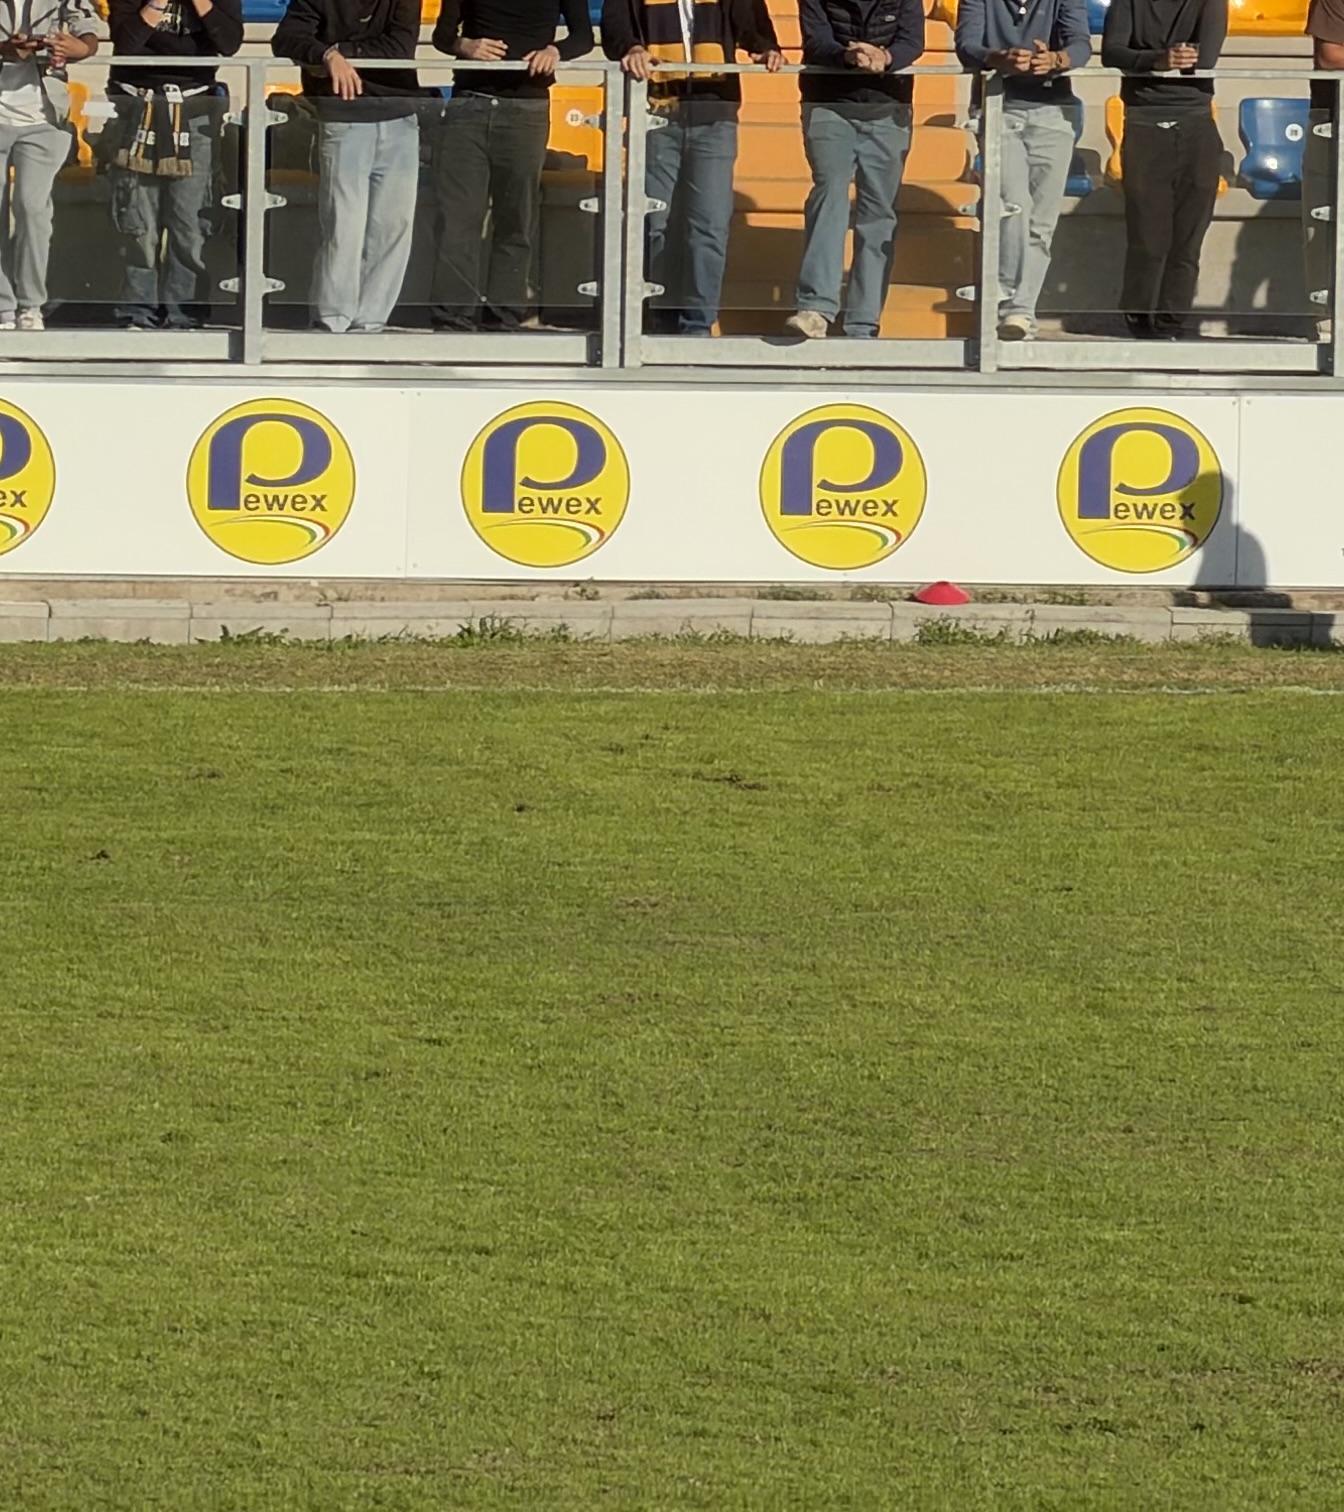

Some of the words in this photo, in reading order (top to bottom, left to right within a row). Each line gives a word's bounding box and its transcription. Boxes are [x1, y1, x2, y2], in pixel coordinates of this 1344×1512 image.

[209, 415, 330, 509] Pewex
[483, 418, 605, 512] Pewex
[781, 421, 901, 514] Pewex
[1079, 425, 1198, 520] Pewex
